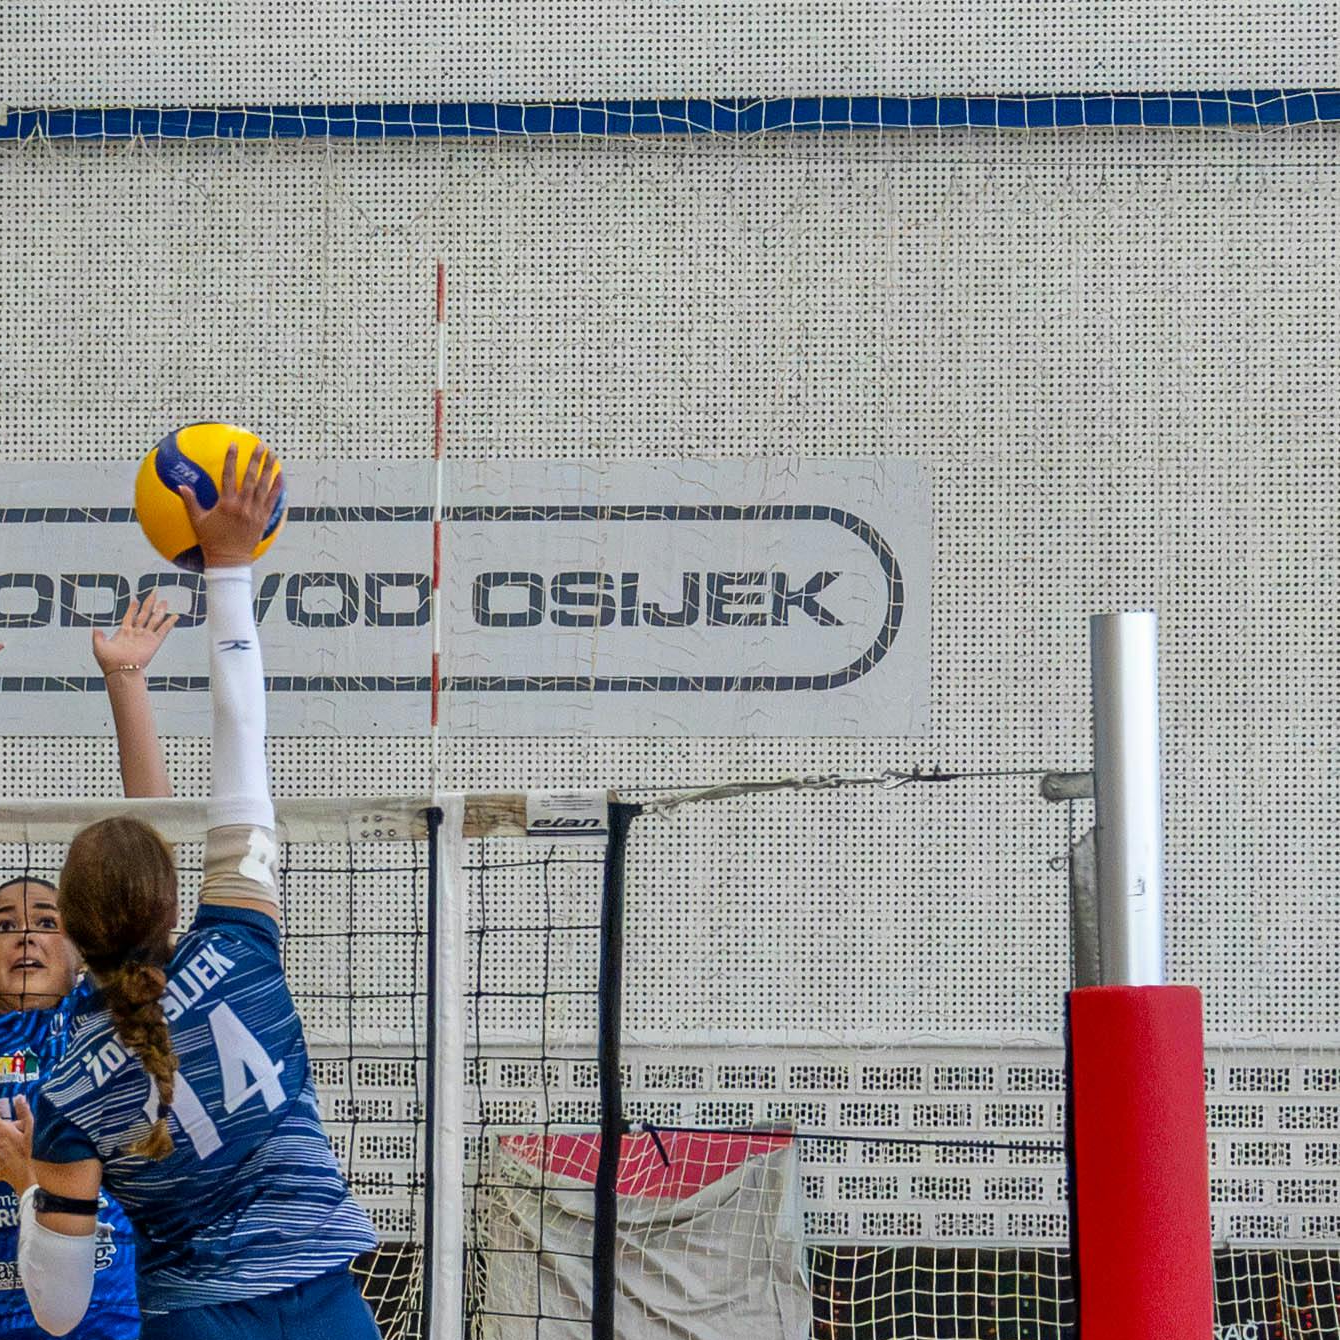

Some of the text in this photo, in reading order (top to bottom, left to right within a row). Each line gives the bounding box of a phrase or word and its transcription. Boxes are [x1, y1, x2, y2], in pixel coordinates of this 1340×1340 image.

[472, 571, 845, 627] OSIJEK
[532, 817, 601, 828] elan
[159, 943, 236, 1024] SIJEK
[143, 1001, 288, 1160] 14
